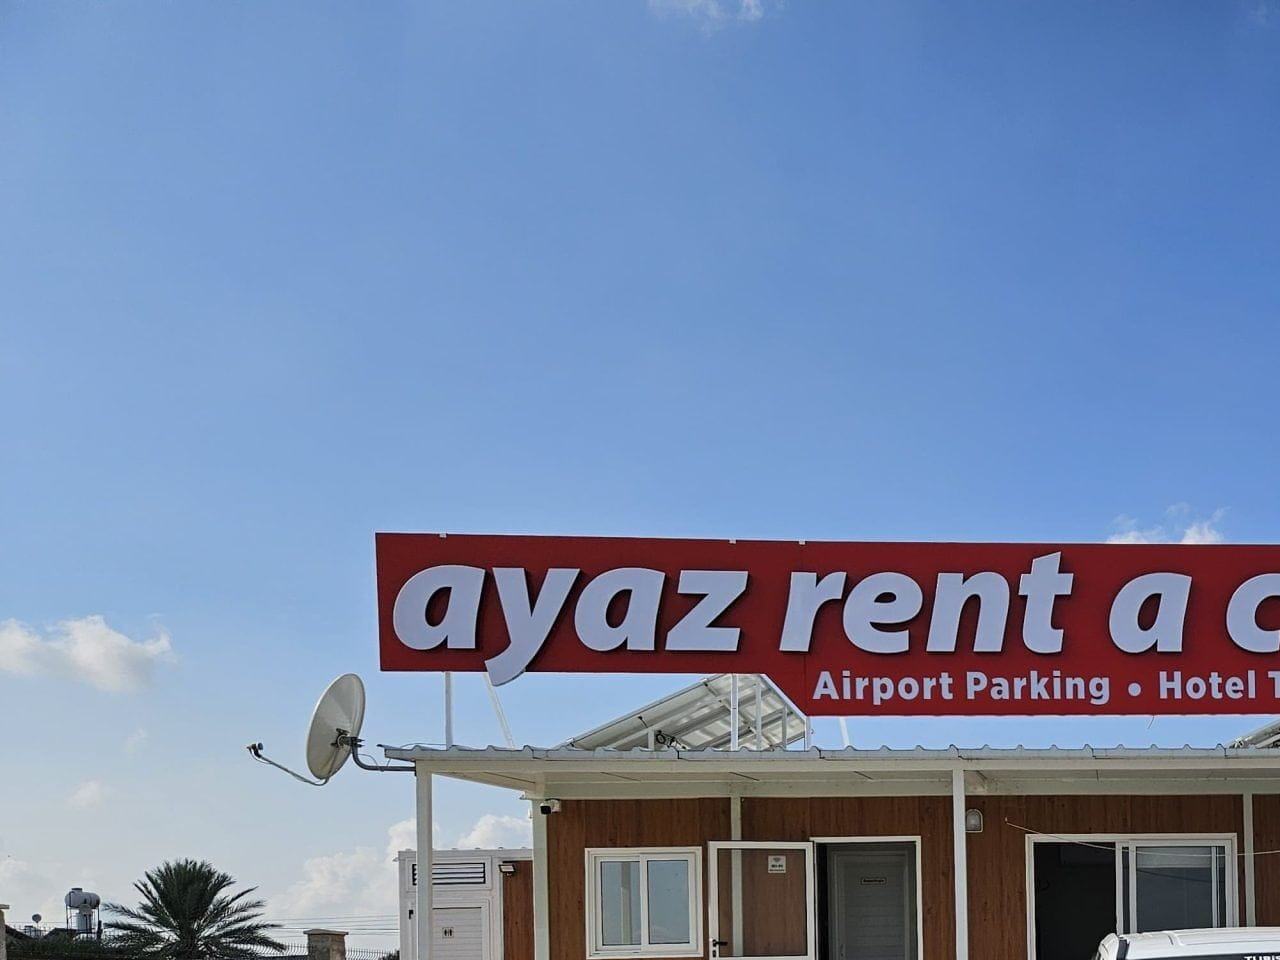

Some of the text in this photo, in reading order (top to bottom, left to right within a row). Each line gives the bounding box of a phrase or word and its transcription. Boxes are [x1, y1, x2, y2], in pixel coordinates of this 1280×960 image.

[393, 564, 749, 686] ayaz
[779, 551, 1074, 654] rent
[1109, 572, 1192, 653] a
[812, 670, 953, 705] Airport
[966, 670, 1110, 705] Parking
[1159, 670, 1256, 699] Hotel
